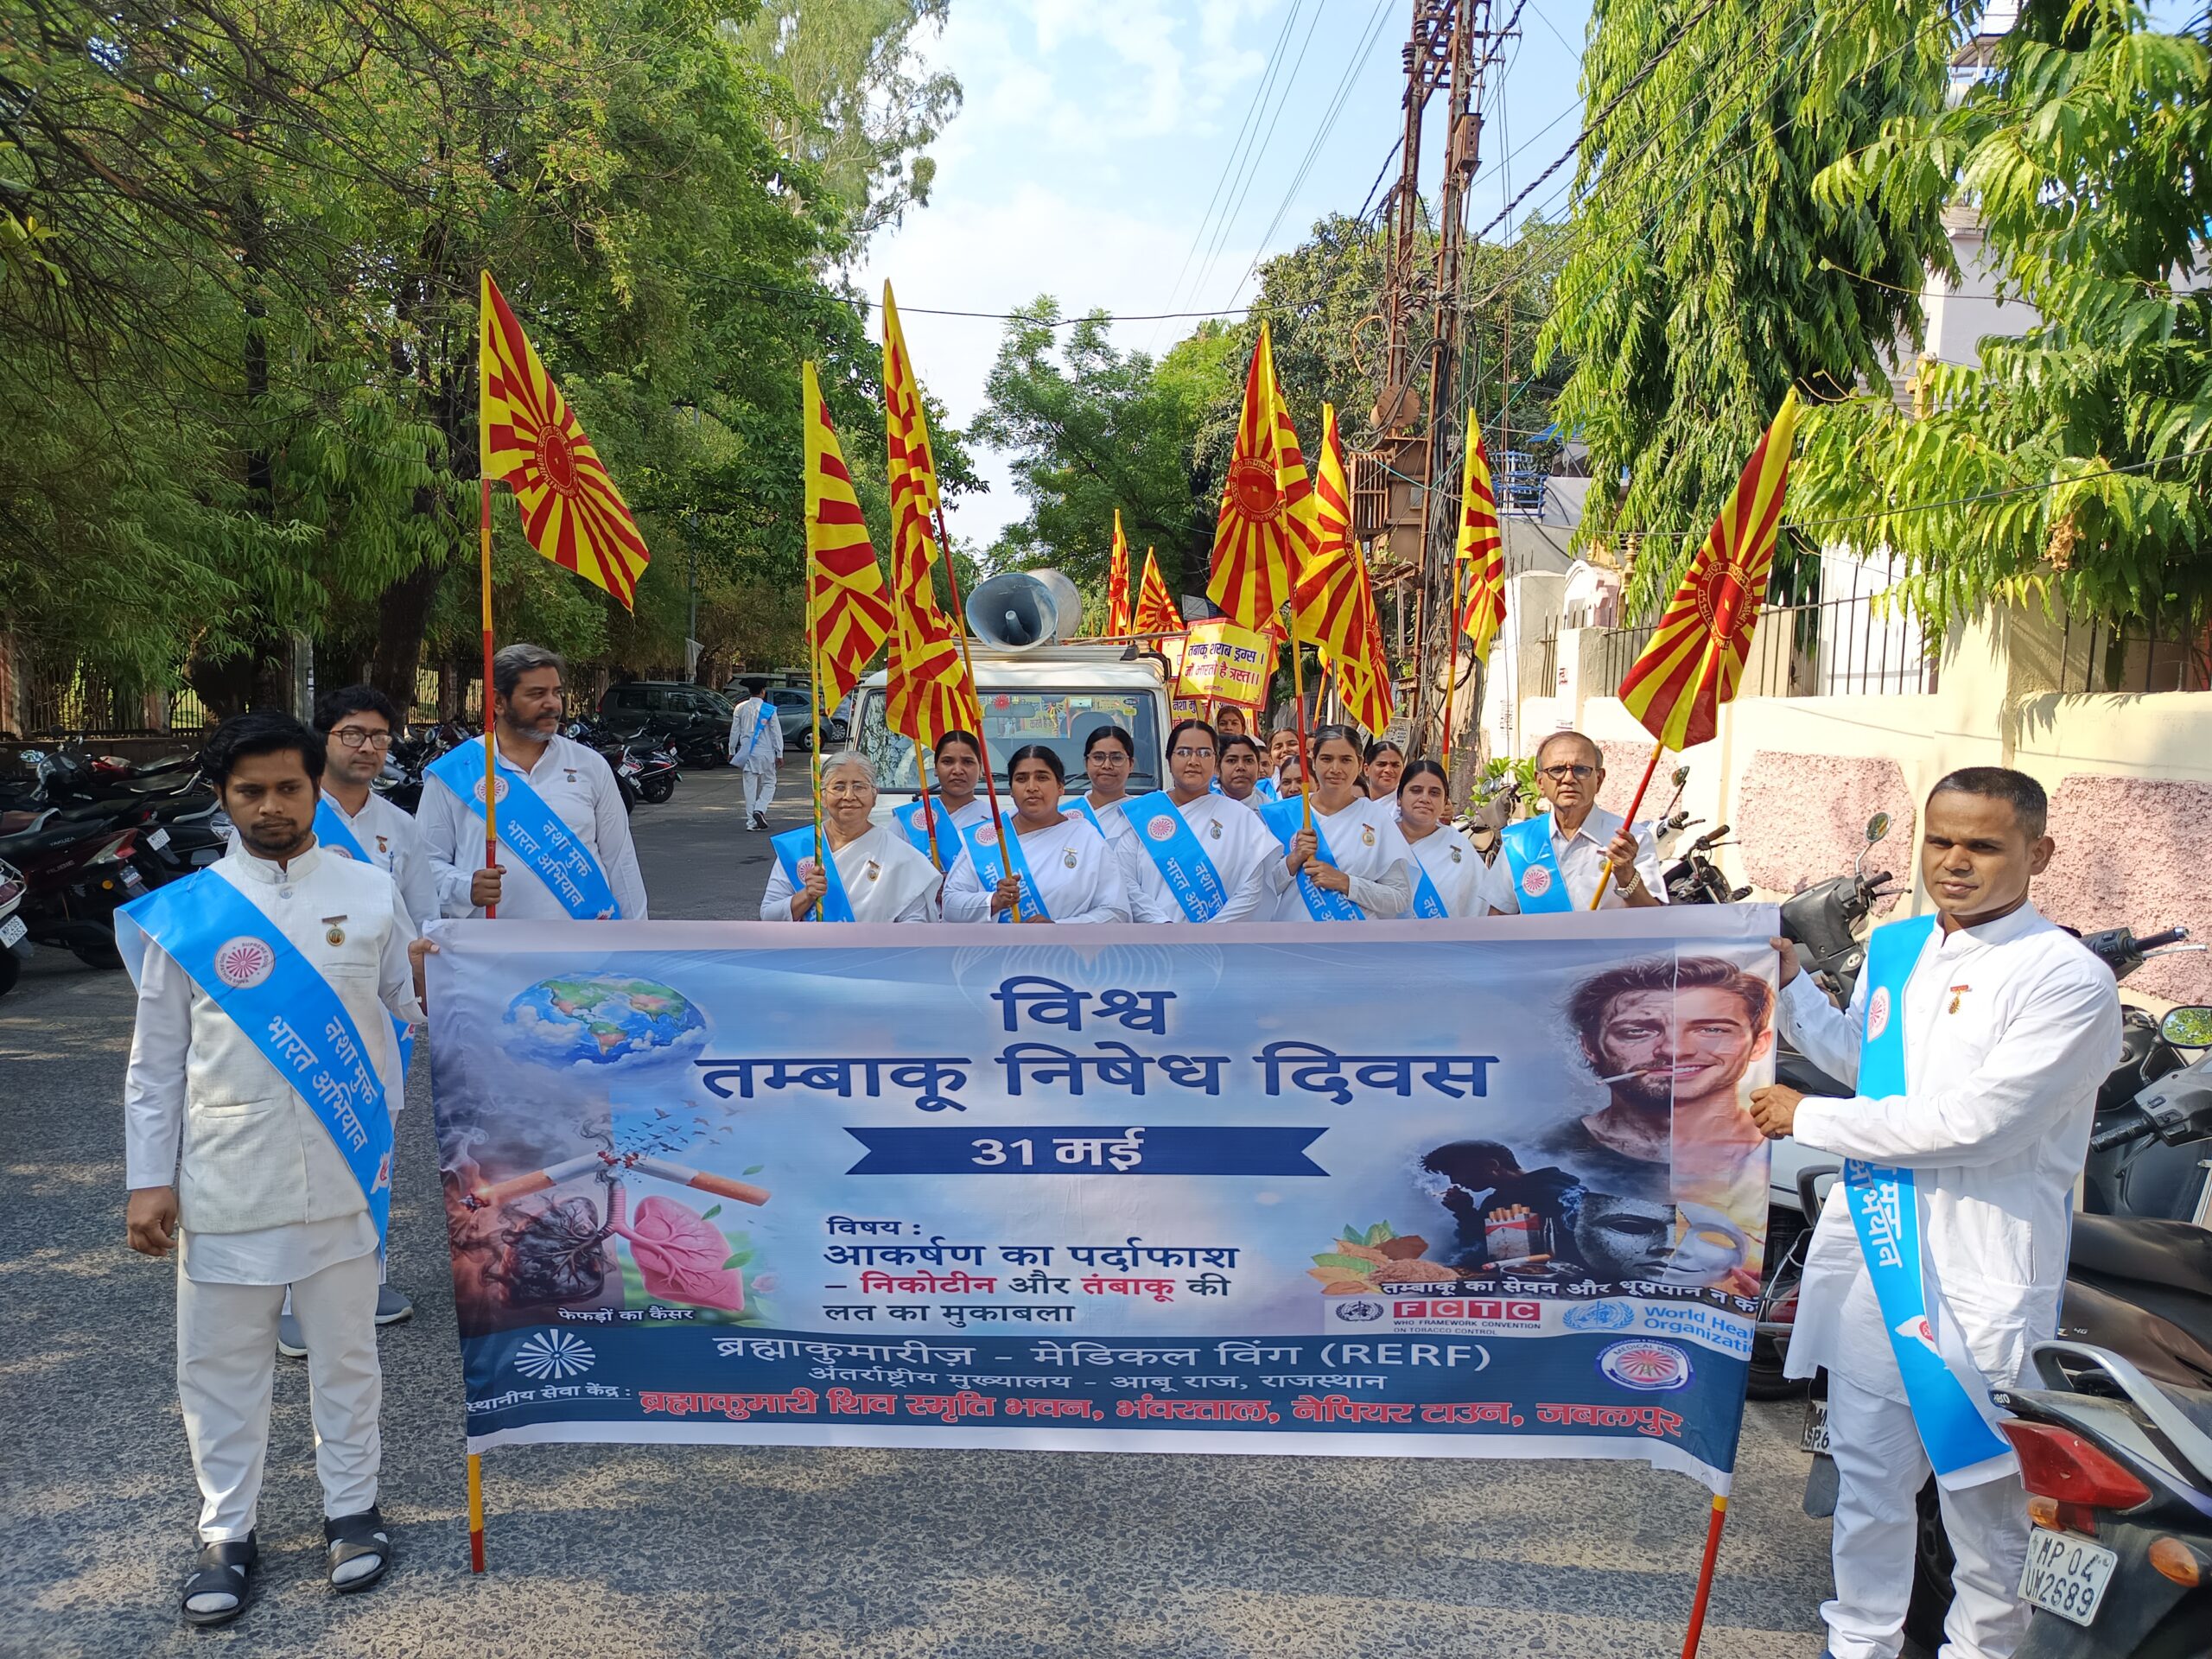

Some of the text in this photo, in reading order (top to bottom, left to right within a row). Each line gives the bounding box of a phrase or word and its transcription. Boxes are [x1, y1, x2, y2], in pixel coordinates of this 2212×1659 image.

[1210, 643, 1232, 657] शराब
[1219, 661, 1228, 678] है
[543, 819, 572, 851] नशा
[508, 819, 585, 907] भारत अभियान
[1166, 856, 1190, 891] भारत
[1195, 861, 1217, 892] नशा
[990, 976, 1178, 1035] विश्व
[326, 1015, 378, 1104] नशा मुक्त
[268, 1015, 368, 1154] भारत अभियान
[693, 1040, 1501, 1113] तम्बाकू निषेध दिवस
[971, 1127, 1147, 1173] 31 मई
[826, 1215, 902, 1236] विषय
[823, 1236, 1241, 1272] आकर्षण का पर्दाफाश
[859, 1269, 998, 1294] निकोटीन
[1008, 1269, 1071, 1294] और
[1080, 1273, 1176, 1302] तंबाकू
[1185, 1272, 1232, 1296] की
[1382, 1280, 1458, 1296] तम्बाकू
[1464, 1280, 1496, 1293] का
[1502, 1276, 1559, 1294] सेवन
[1566, 1279, 1612, 1295] और
[1619, 1280, 1704, 1297] धूम्रपान
[1709, 1287, 1728, 1304] न
[558, 1306, 695, 1323] फेफड़ों का कैंसर
[823, 1306, 1076, 1328] लत का मुकाबला
[1401, 1302, 1535, 1319] FCTC
[1481, 1321, 1541, 1330] CONVENTION
[1644, 1306, 1754, 1341] World Heal
[1613, 1343, 1682, 1360] MEDICAL WING
[1644, 1319, 1753, 1354] Organizati
[712, 1338, 977, 1366] ब्रह्माकुमारीज़
[1030, 1340, 1202, 1367] मेडिकल
[1213, 1339, 1303, 1366] विंग
[1320, 1343, 1491, 1371] (RERF)
[540, 1384, 582, 1399] सेवा
[587, 1382, 620, 1398] केंद्र
[809, 1365, 938, 1388] अंतर्राष्ट्रीय
[946, 1374, 1072, 1389] मुख्यालय
[1109, 1376, 1179, 1392] आबू
[1182, 1376, 1248, 1390] राज,
[1258, 1375, 1388, 1389] राजस्थान
[639, 1387, 1684, 1437] ब्रह्माकुमारी शिव स्मृति भवन, भंवरताल, नेपियर टाउन, जबलपुर
[2036, 1537, 2100, 1582] MP 04
